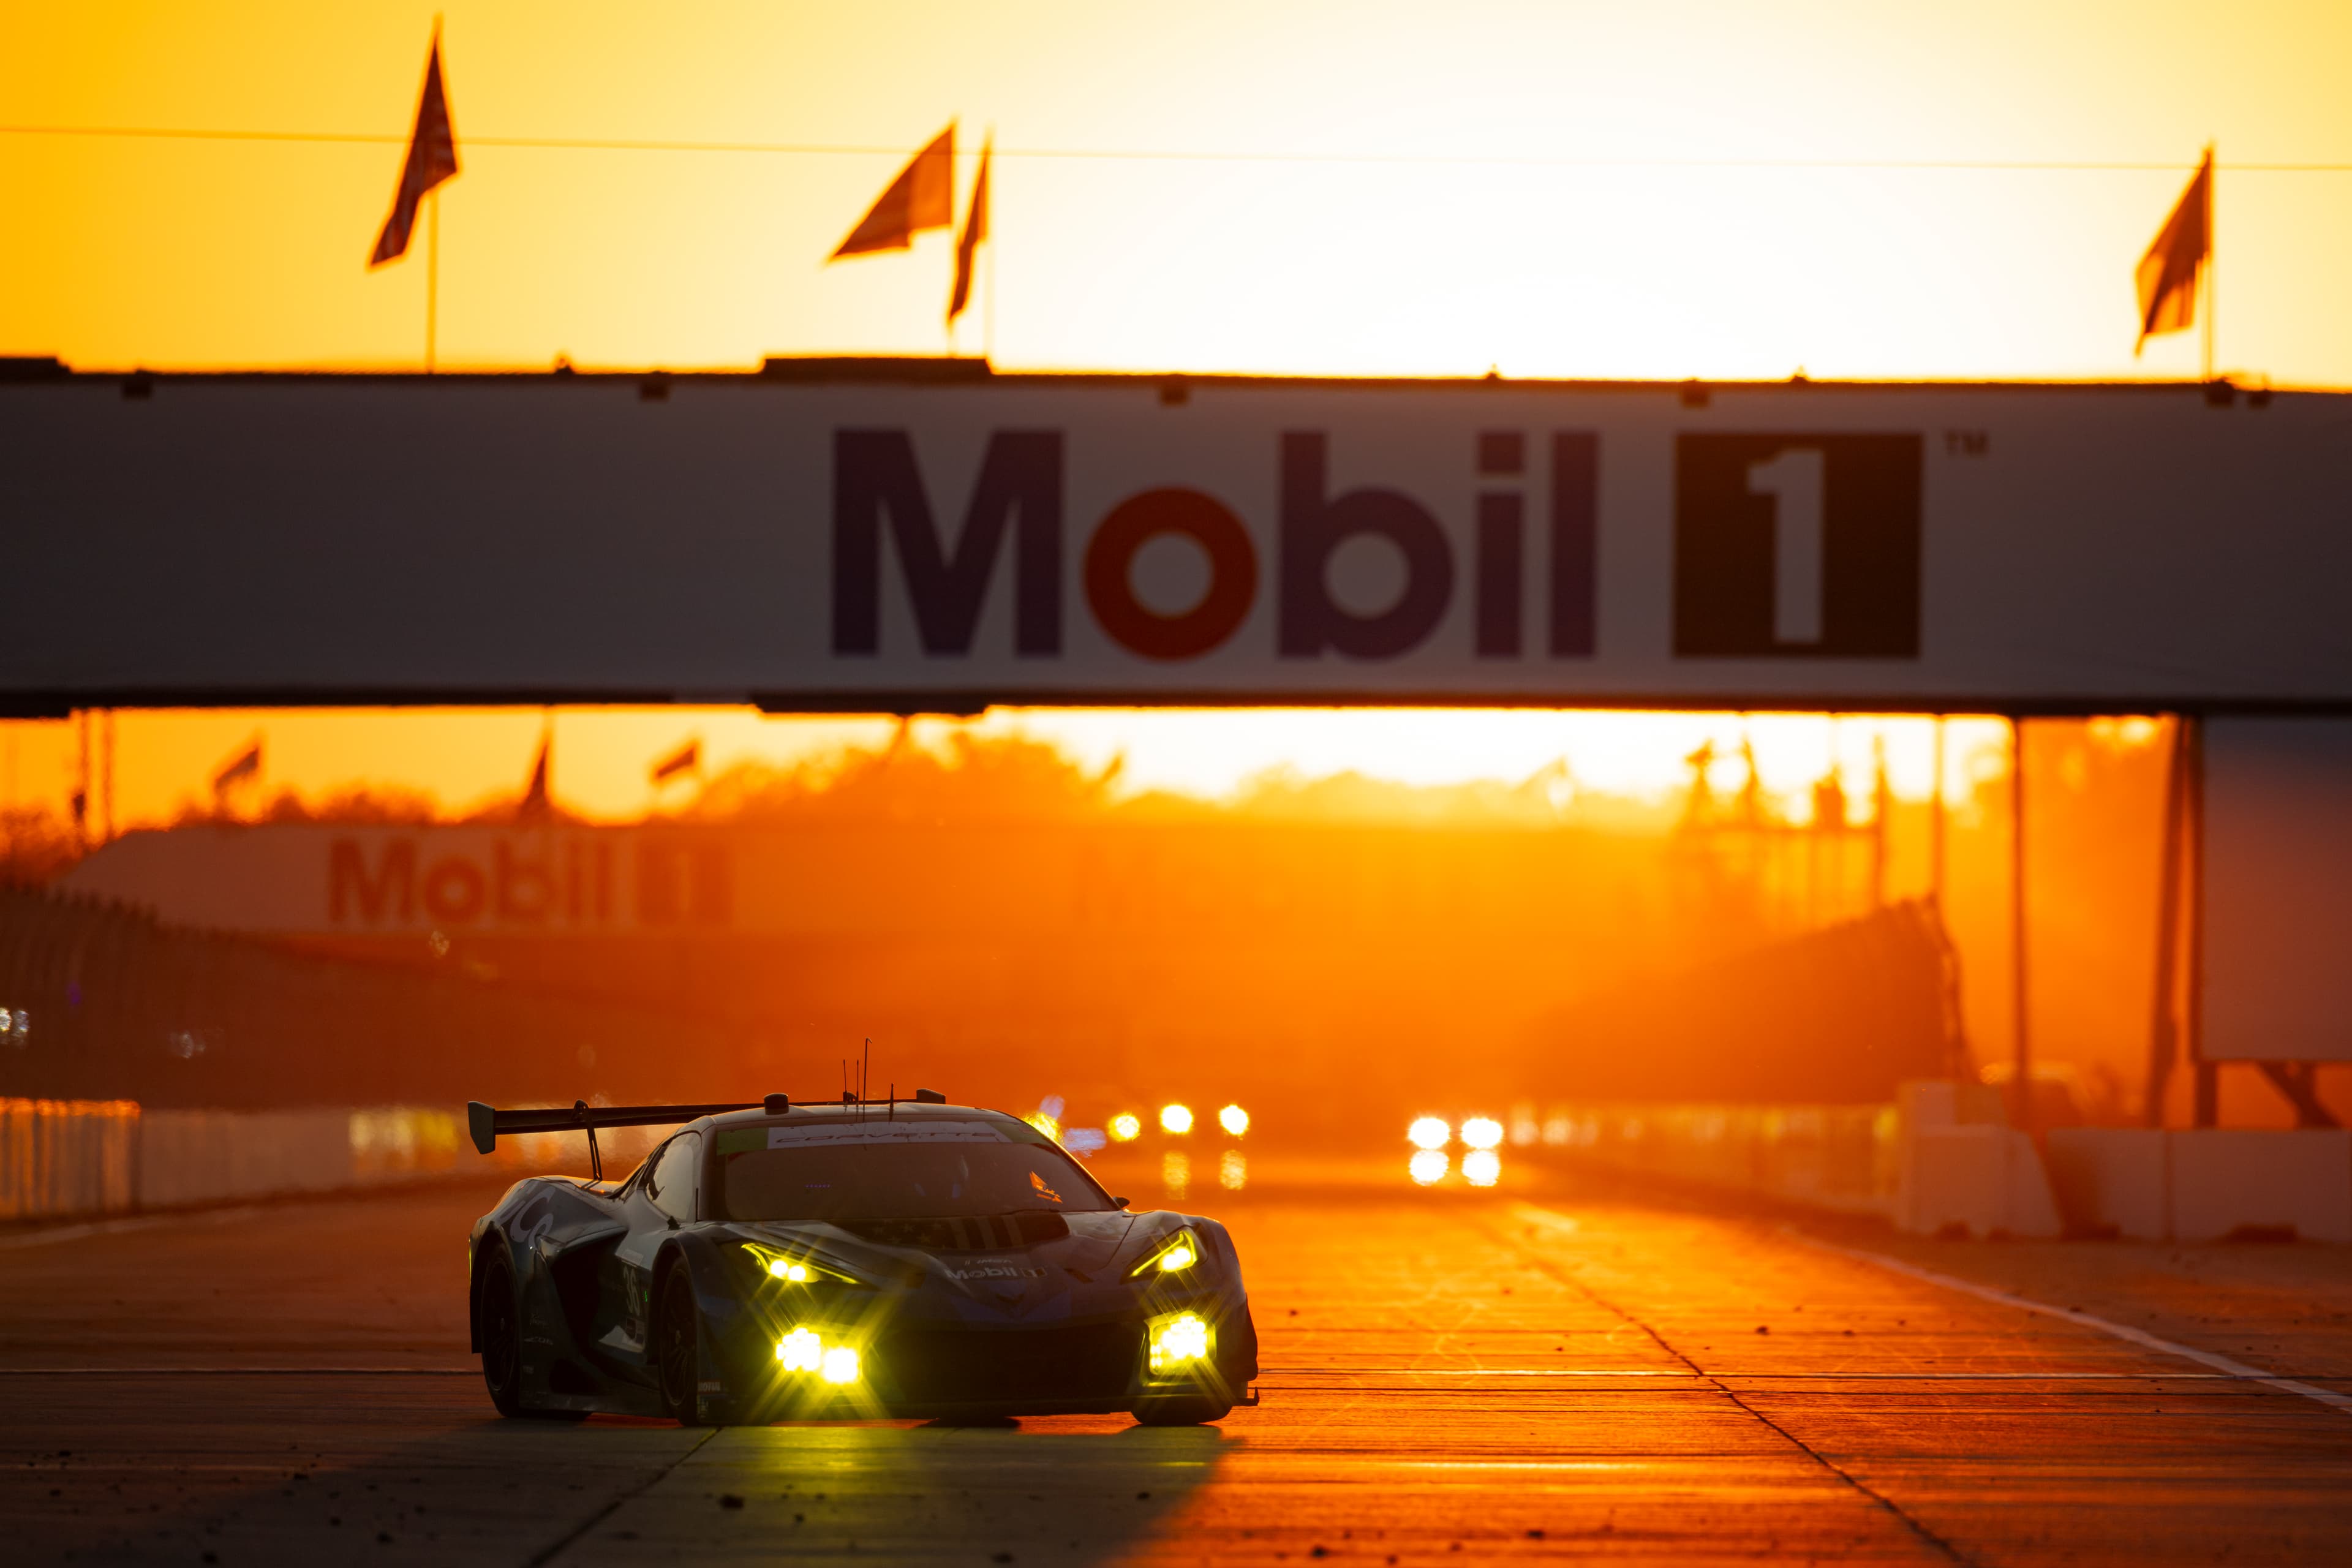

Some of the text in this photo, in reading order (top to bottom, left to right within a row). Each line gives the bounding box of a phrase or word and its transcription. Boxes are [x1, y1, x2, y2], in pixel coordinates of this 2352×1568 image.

[831, 427, 1599, 662] Mobil
[1746, 447, 1826, 646] 1
[328, 837, 611, 925] Mobil
[775, 1131, 997, 1144] CORVETTE
[943, 1267, 1019, 1280] Mobil
